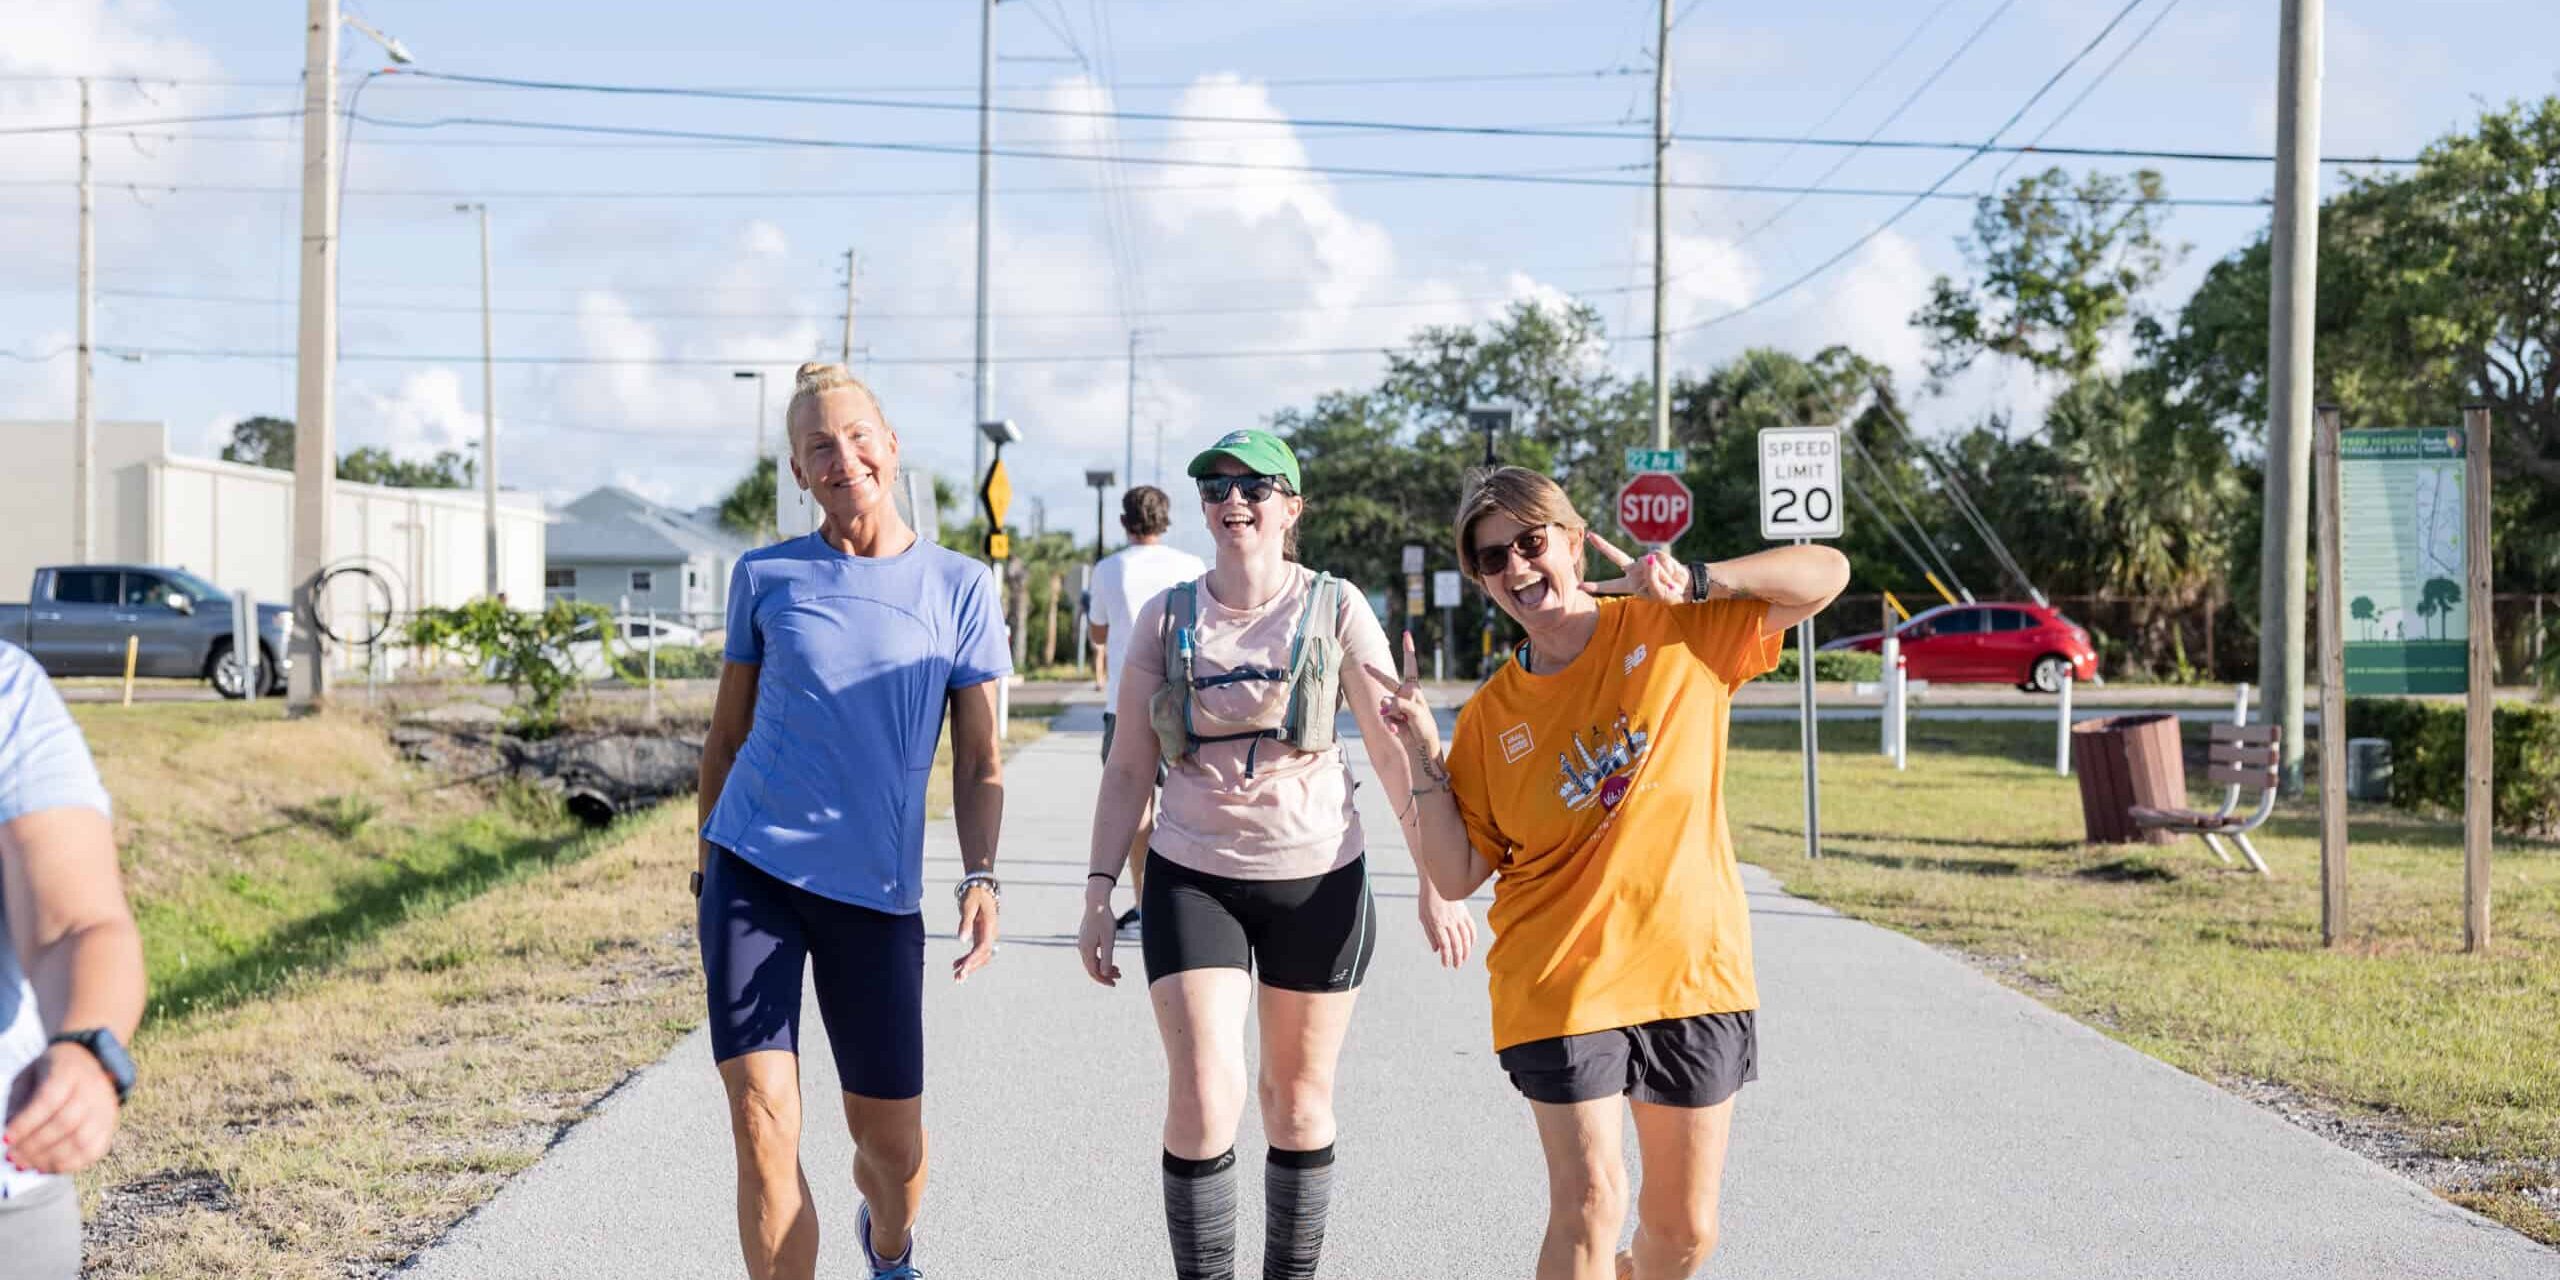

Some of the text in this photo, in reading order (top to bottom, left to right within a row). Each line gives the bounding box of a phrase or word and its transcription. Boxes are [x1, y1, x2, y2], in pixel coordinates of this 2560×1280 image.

[1768, 441, 1832, 457] SPEED
[1629, 452, 1648, 470] 22
[1775, 463, 1824, 479] LIMIT
[1623, 494, 1686, 523] STOP
[1771, 487, 1832, 523] 20
